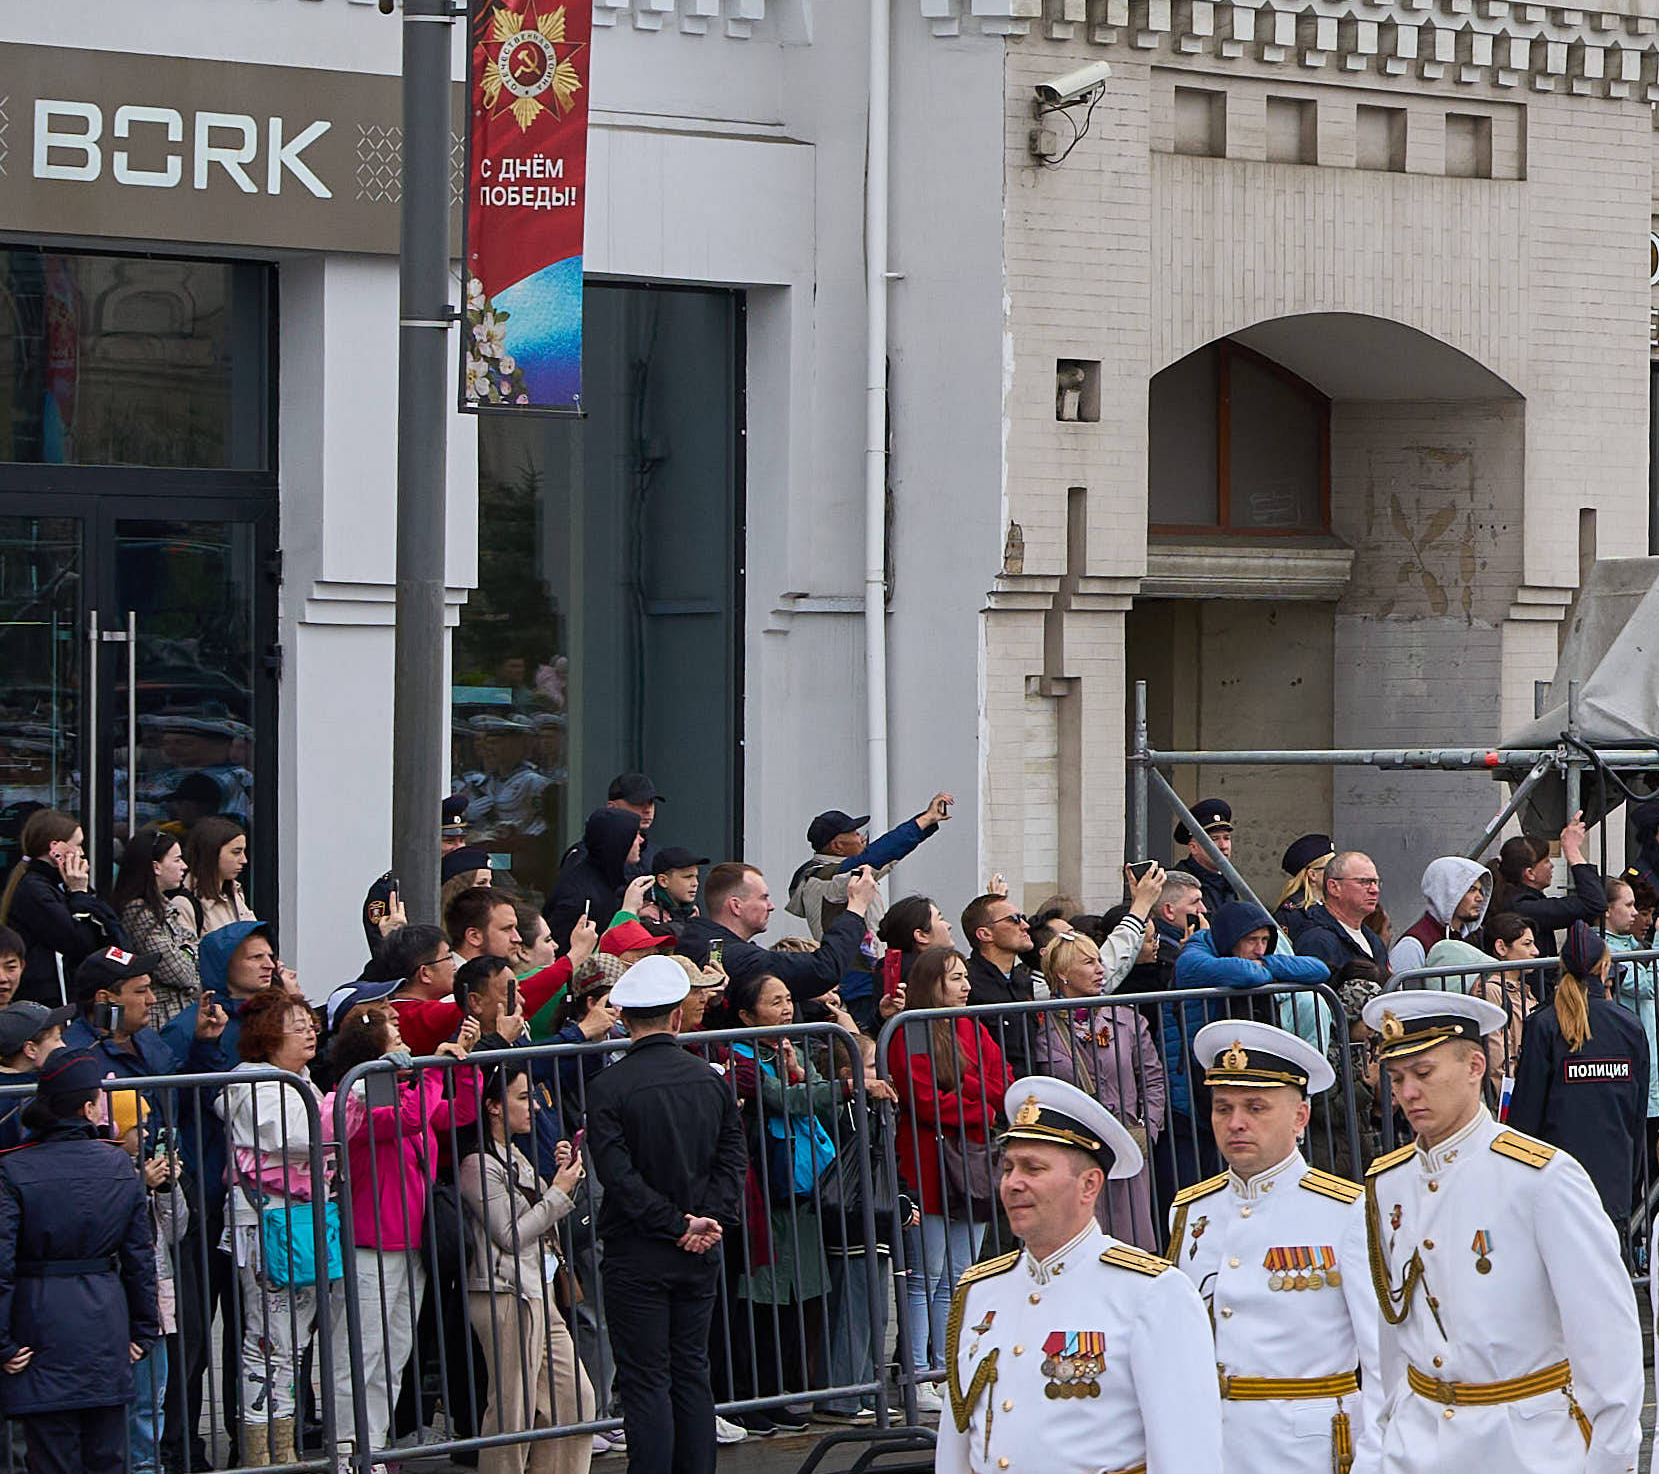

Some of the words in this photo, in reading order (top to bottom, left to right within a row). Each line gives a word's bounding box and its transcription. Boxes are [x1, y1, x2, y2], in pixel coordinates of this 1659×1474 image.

[33, 99, 333, 199] BORK
[481, 159, 492, 179] С
[499, 153, 563, 182] ДНЁМ
[480, 186, 577, 211] ПОБЕДЫ!
[1568, 1063, 1629, 1078] ПОЛИЦИЯ
